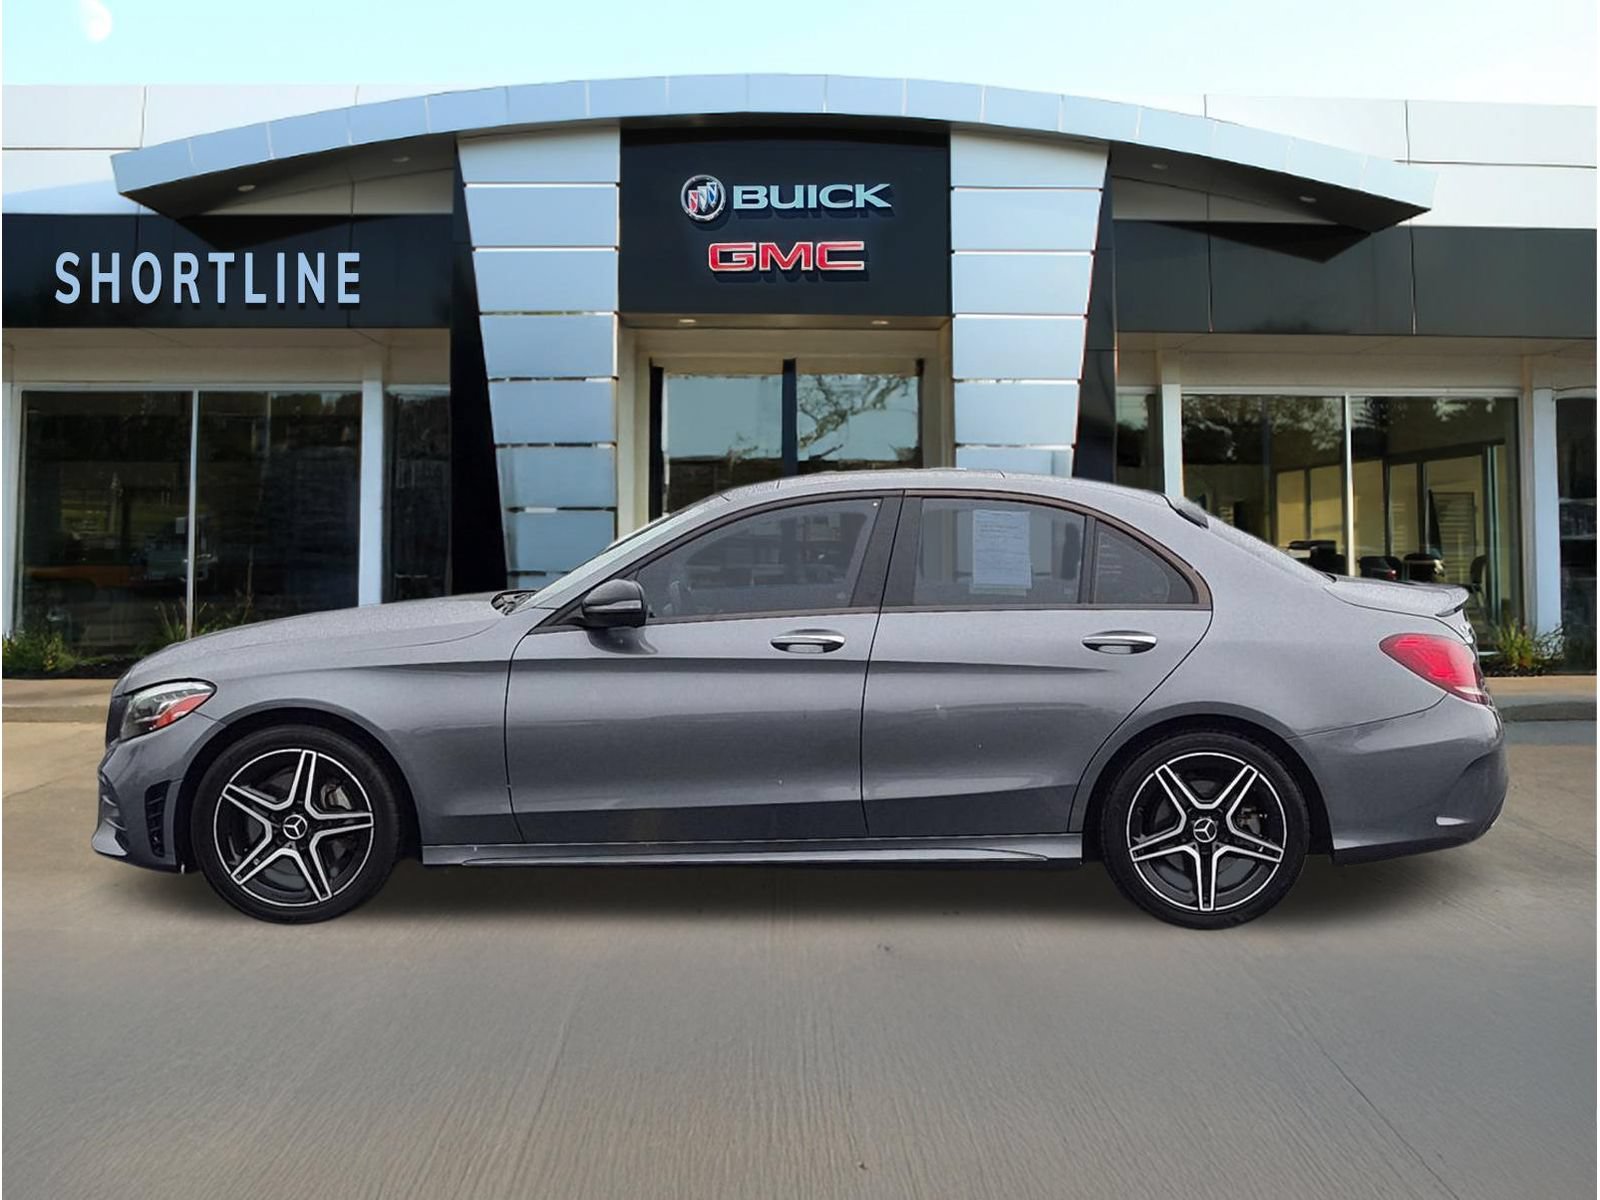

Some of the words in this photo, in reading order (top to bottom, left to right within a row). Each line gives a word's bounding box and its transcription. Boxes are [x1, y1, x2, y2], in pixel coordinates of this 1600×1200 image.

[733, 183, 892, 210] BUICK
[708, 241, 865, 271] GMC
[54, 251, 361, 304] SHORTLINE
